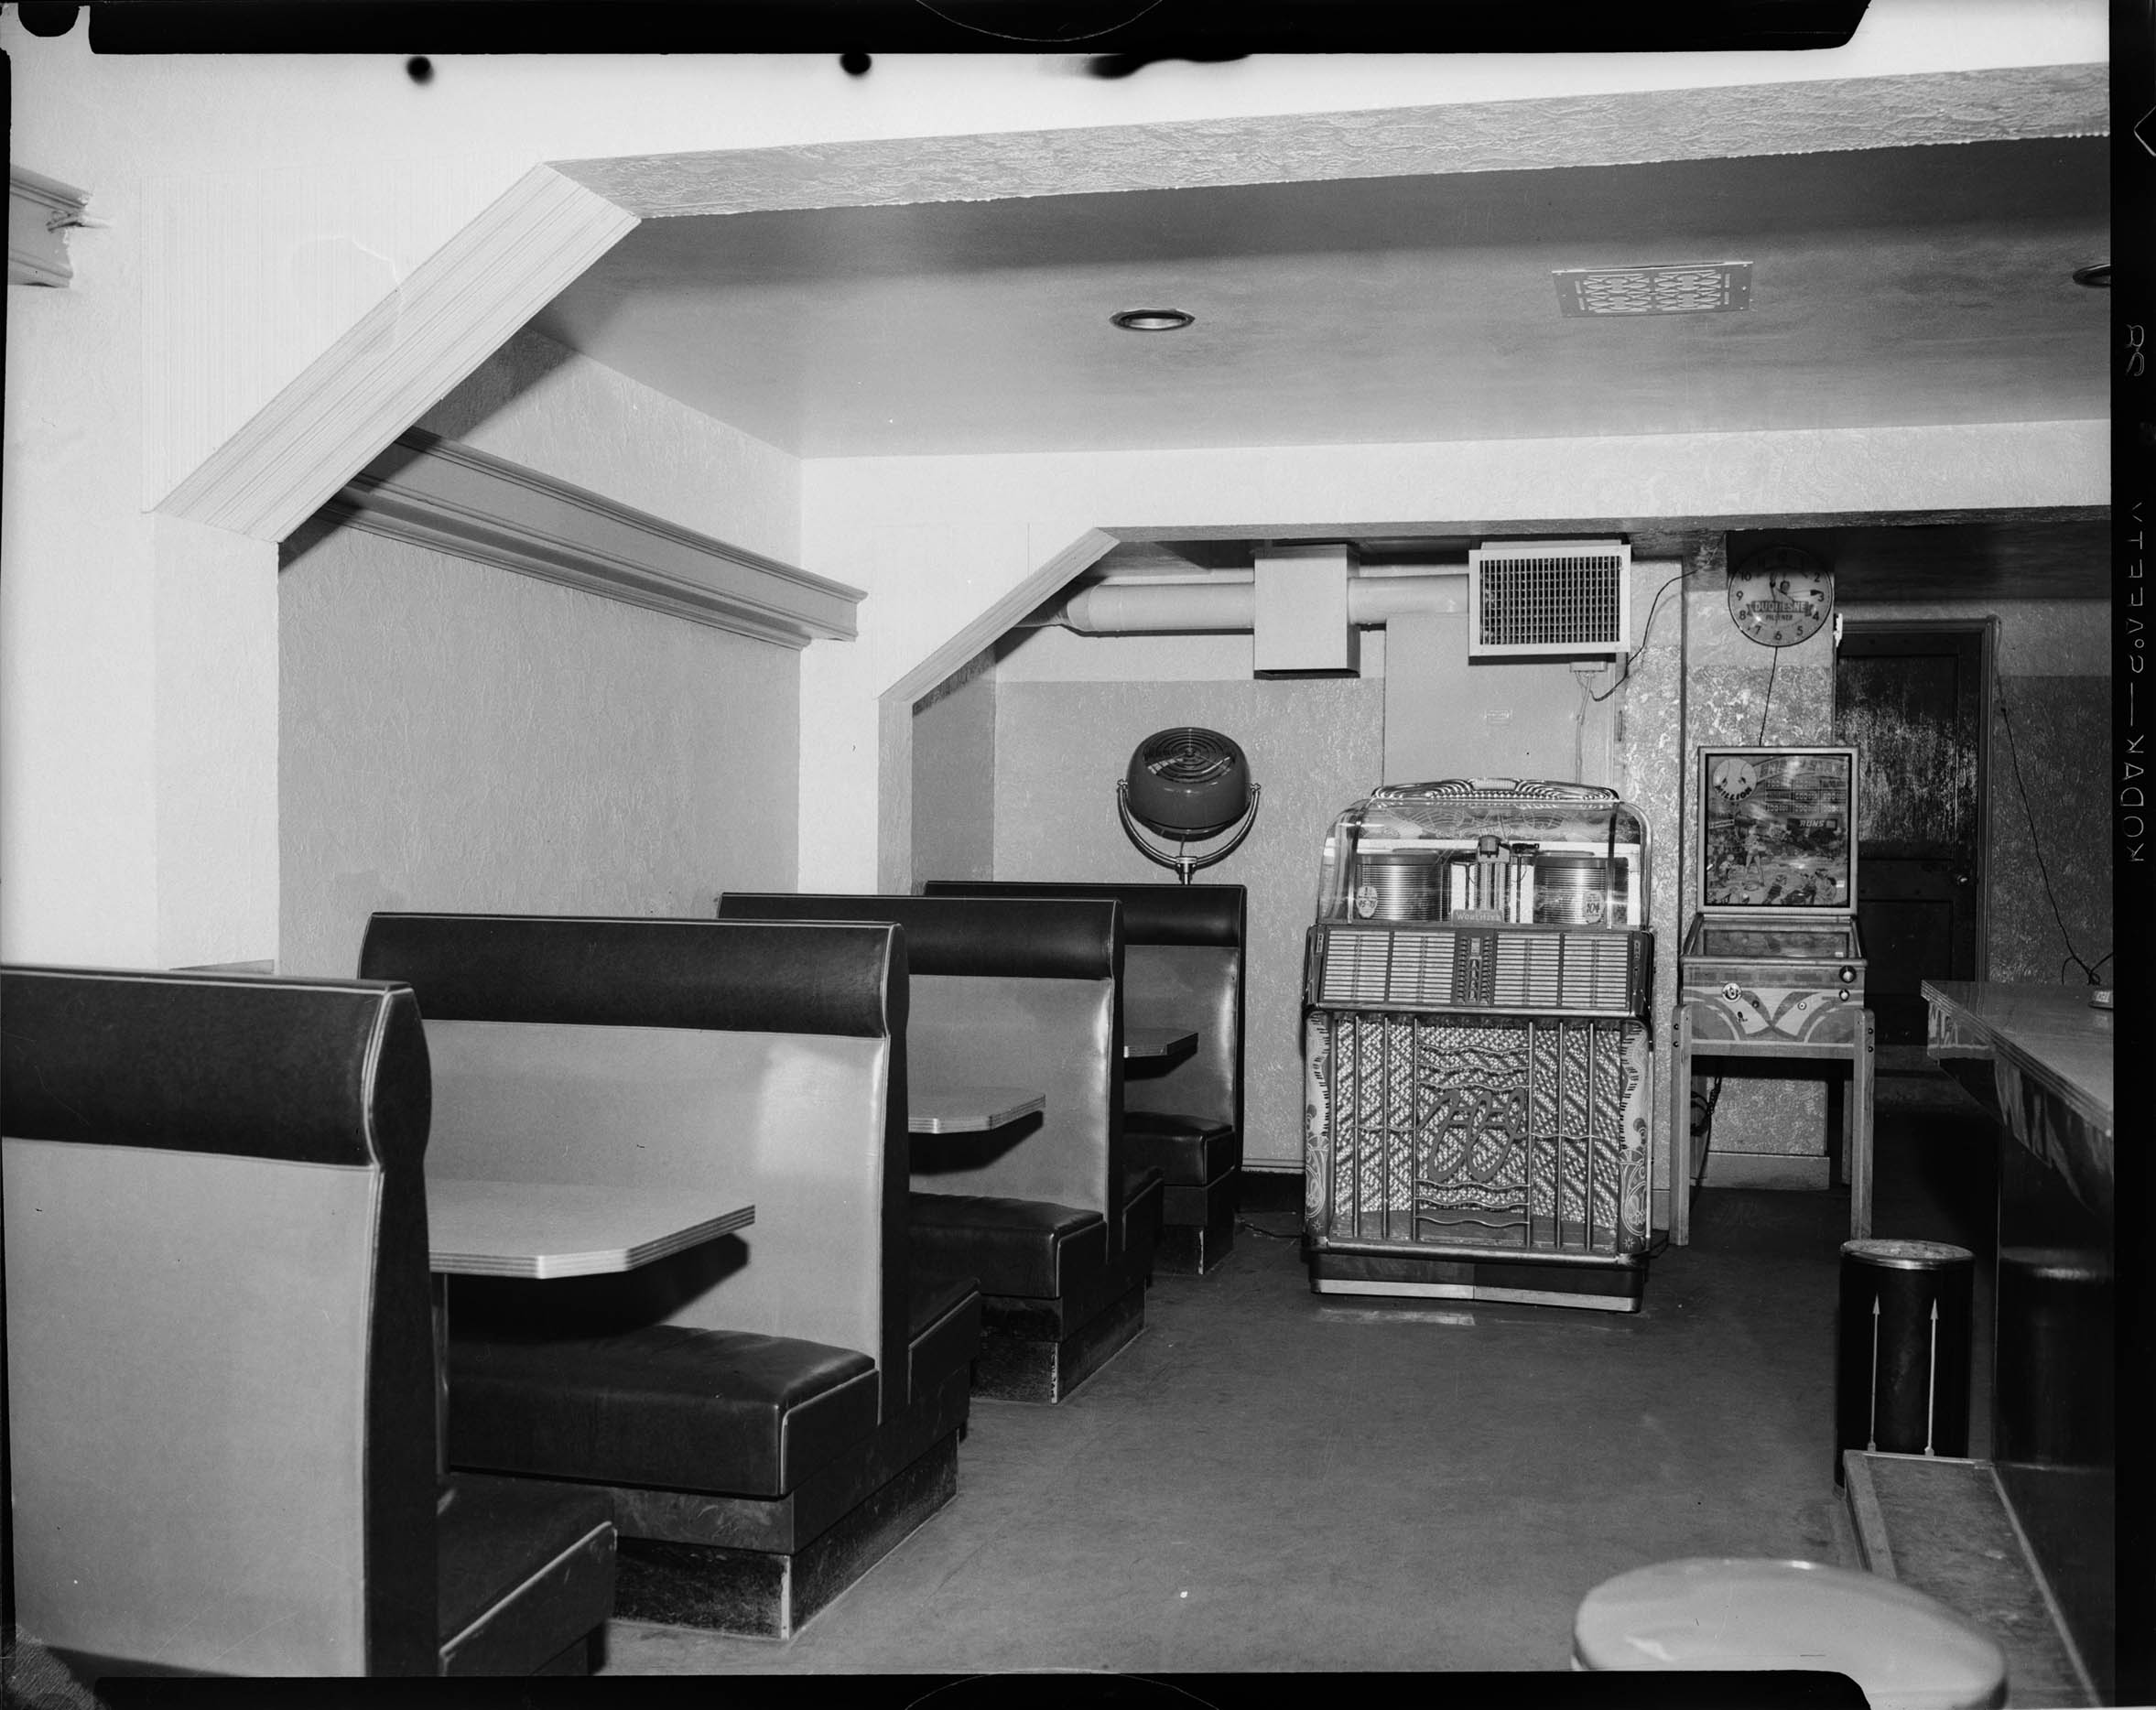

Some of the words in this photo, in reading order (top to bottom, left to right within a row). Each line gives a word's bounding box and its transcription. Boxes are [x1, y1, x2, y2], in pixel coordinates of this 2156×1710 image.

[1736, 590, 1744, 601] 9
[1739, 610, 1747, 621] 8
[1812, 611, 1820, 621] 4
[1755, 625, 1762, 635] 7
[1796, 626, 1804, 636] 5
[1774, 631, 1782, 641] 6
[1714, 785, 1752, 801] MILLION
